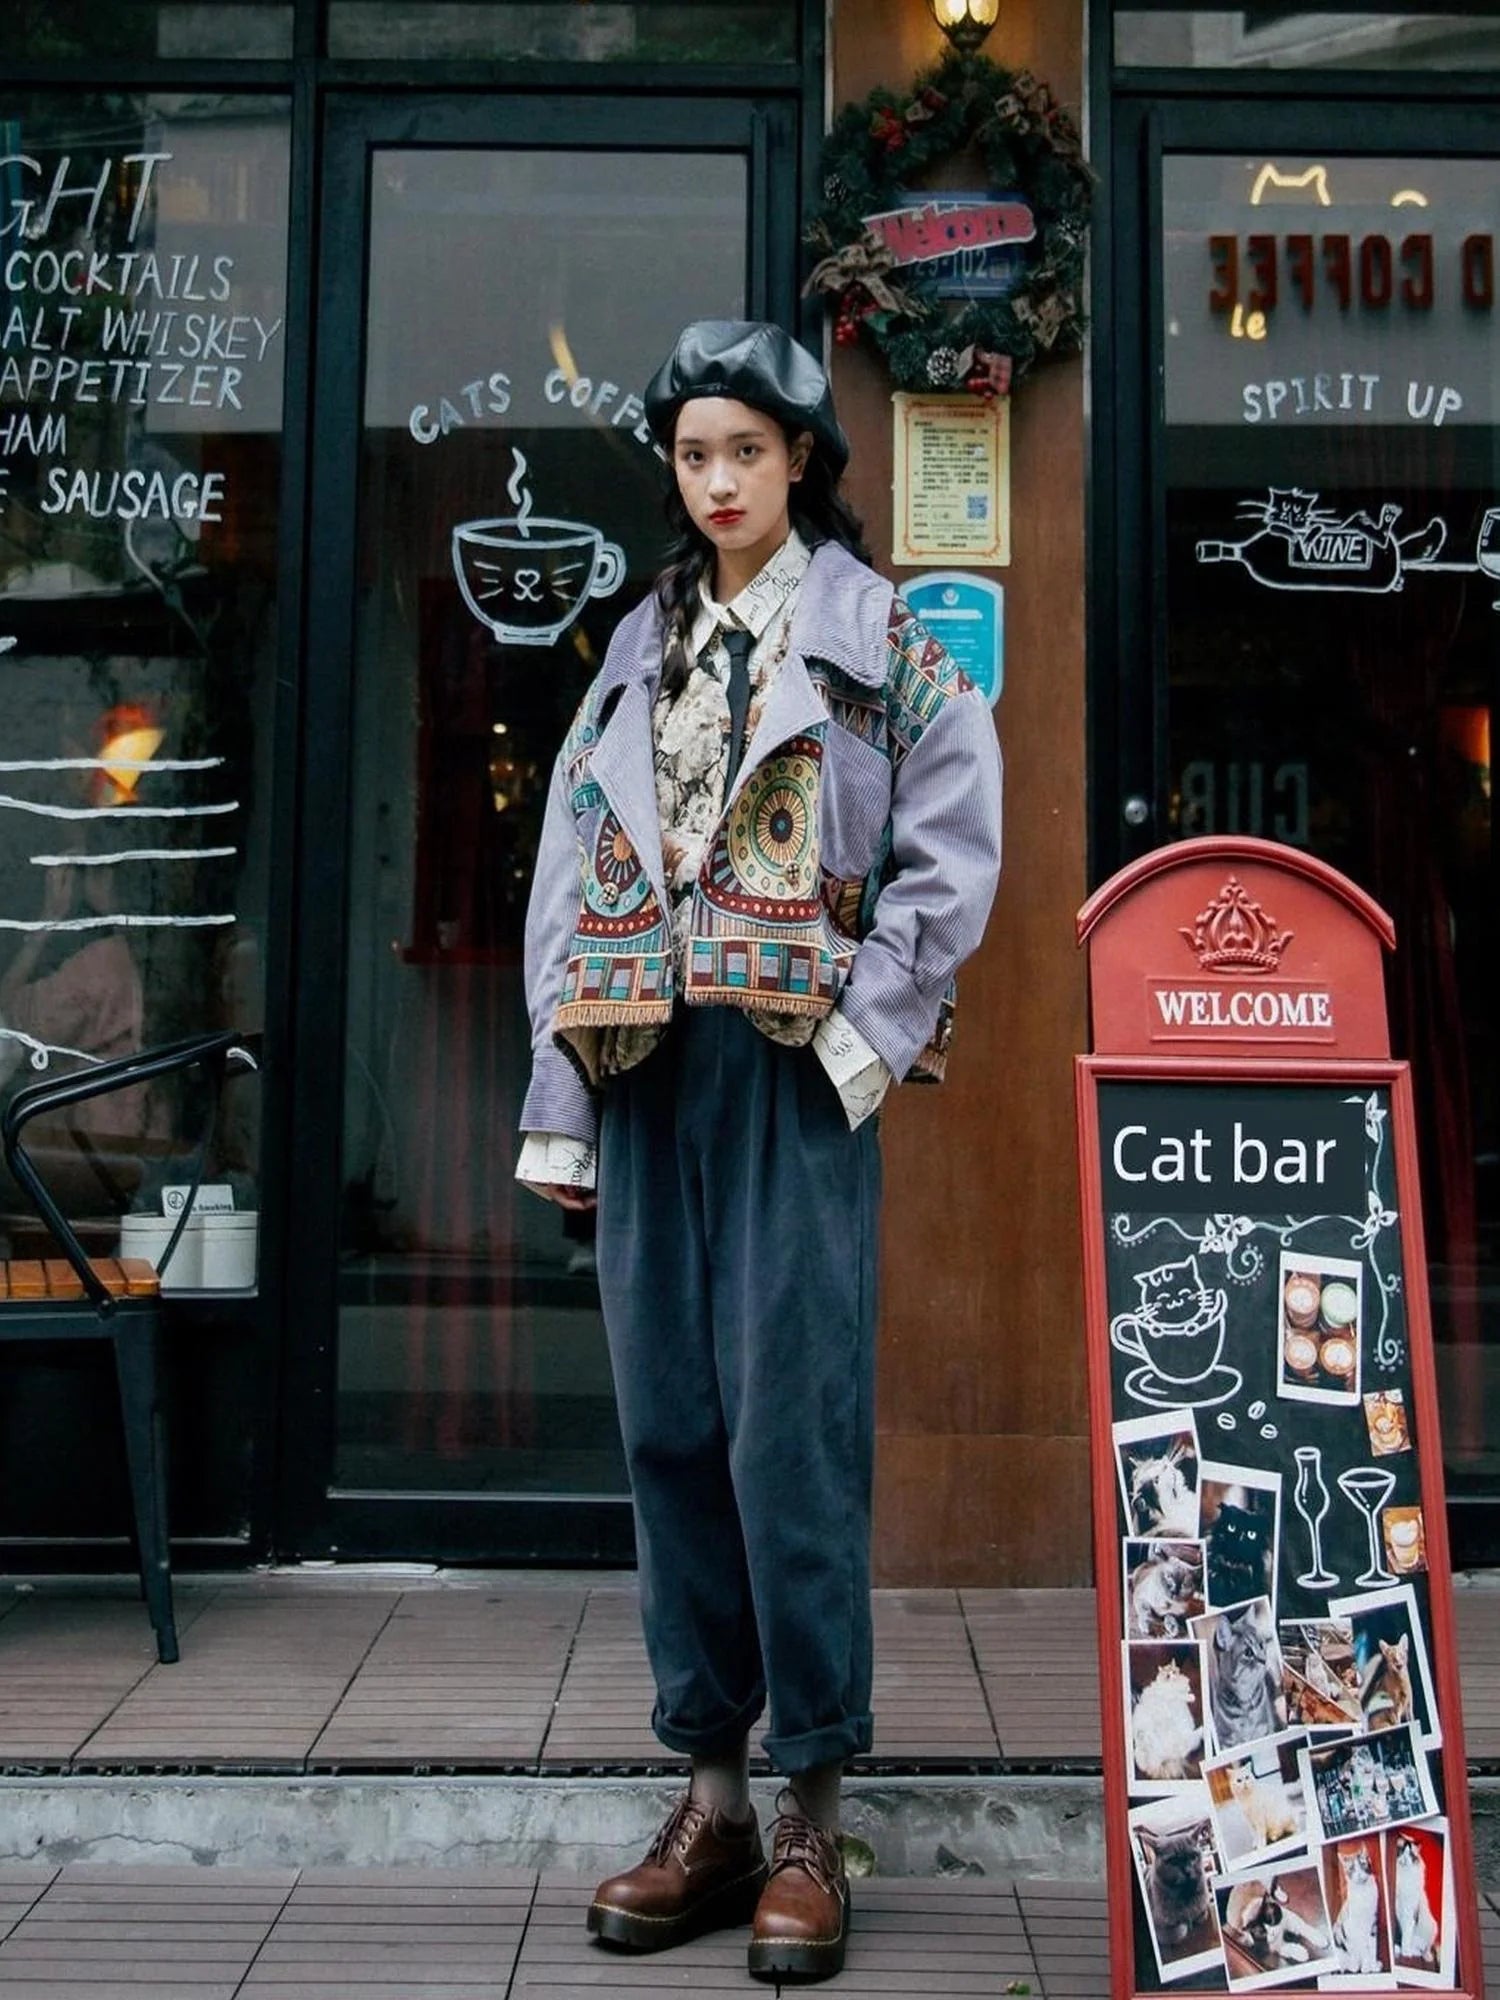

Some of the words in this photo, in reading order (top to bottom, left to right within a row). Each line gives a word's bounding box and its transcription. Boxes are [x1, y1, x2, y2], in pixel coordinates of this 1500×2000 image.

[5, 250, 234, 301] COCKTAILS
[0, 306, 81, 351] ALT
[103, 307, 281, 362] WHISKEY
[0, 356, 242, 410] APPETIZER
[1242, 373, 1380, 422] SPIRIT
[1407, 381, 1463, 426] UP
[409, 373, 512, 444] CATS
[545, 370, 668, 464] COFFE
[41, 467, 226, 522] SAUSAGE
[1300, 534, 1363, 562] WINE
[1155, 991, 1332, 1027] WELCOME
[1112, 1125, 1212, 1182] Cat
[1233, 1122, 1337, 1183] bar
